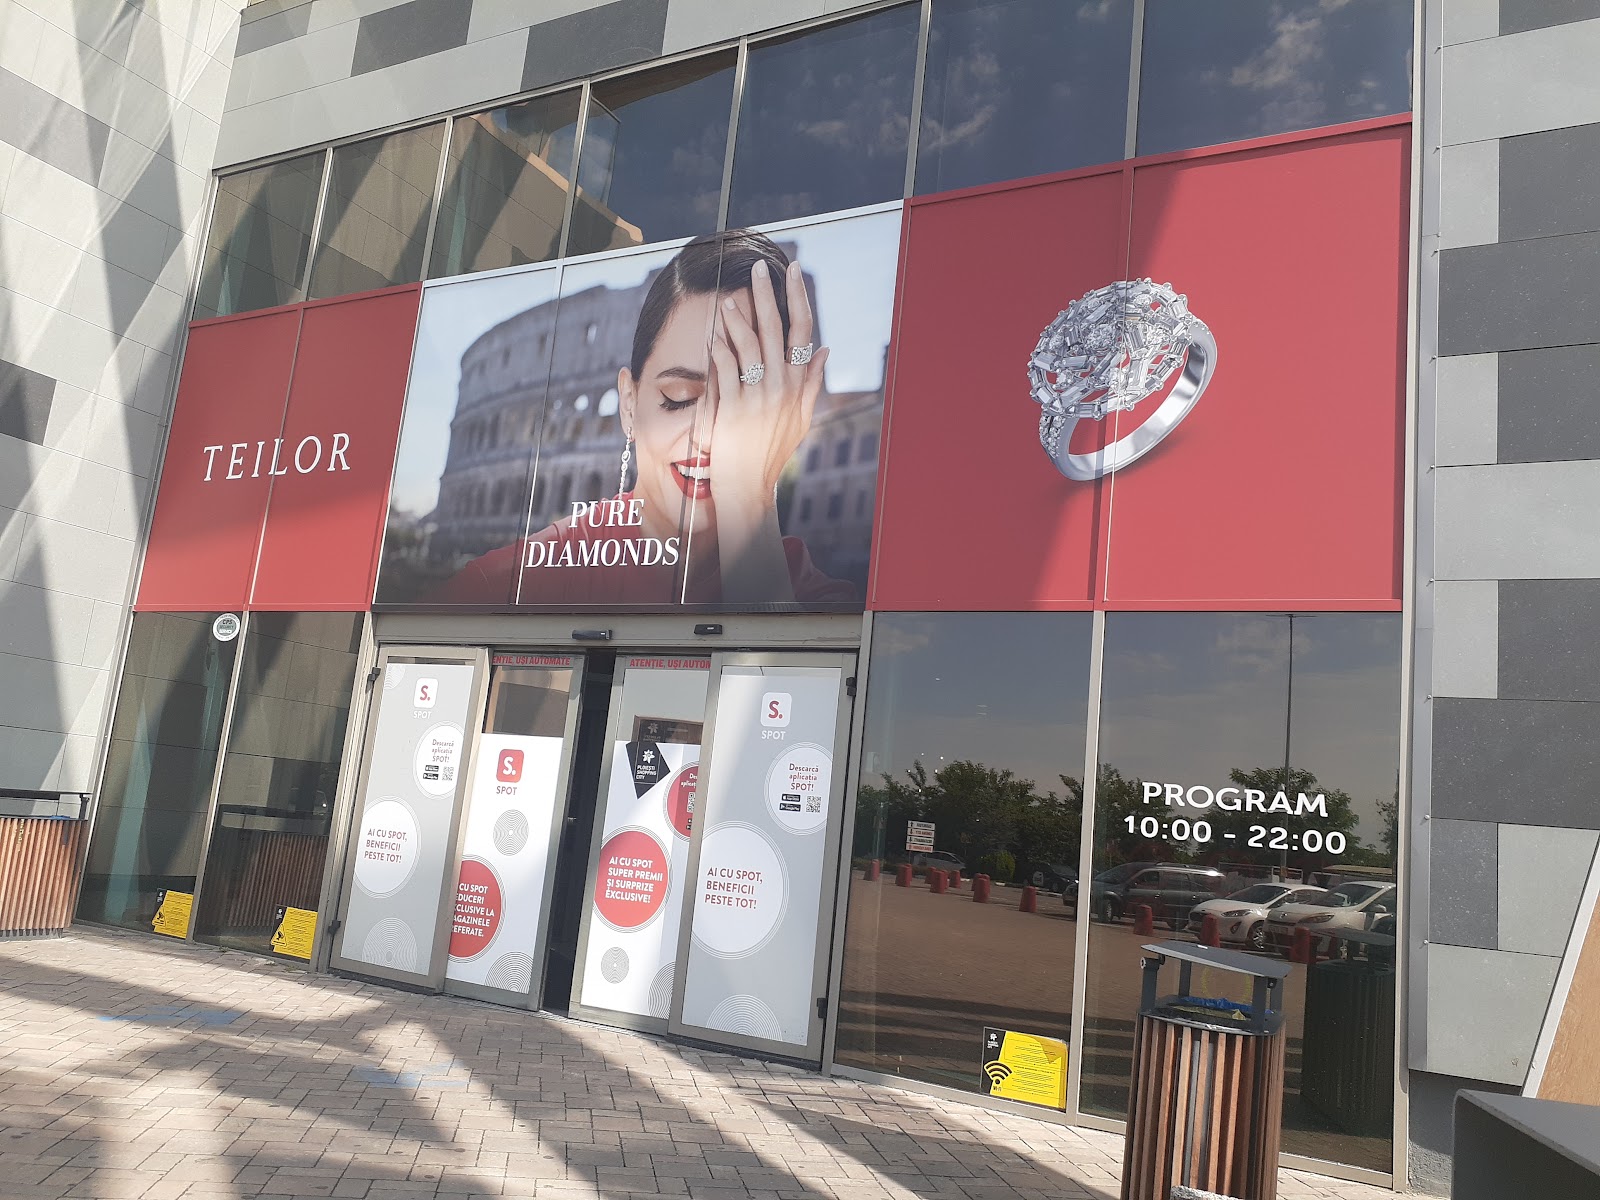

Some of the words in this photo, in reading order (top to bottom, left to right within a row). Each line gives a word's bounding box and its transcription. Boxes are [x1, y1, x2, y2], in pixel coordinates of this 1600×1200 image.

[203, 433, 351, 481] TEILOR
[569, 499, 644, 528] PURE
[525, 536, 680, 568] DIAMONDS
[529, 656, 571, 666] AUTOMATE
[413, 710, 432, 719] SPOT
[761, 730, 786, 741] SPOT
[496, 785, 517, 796] SPOT
[791, 783, 814, 792] SPOT!
[1142, 782, 1329, 818] PROGRAM
[367, 828, 376, 837] AI
[376, 829, 387, 838] CU
[387, 830, 408, 842] SPOT,
[1124, 815, 1212, 843] 10:00
[1247, 825, 1347, 855] 22:00
[366, 839, 401, 852] BENEFICII
[364, 850, 385, 862] PESTE
[385, 852, 402, 864] TOT!
[609, 856, 618, 865] AI
[619, 857, 631, 866] CU
[632, 858, 653, 869] SPOT
[608, 867, 634, 878] SUPER
[635, 870, 663, 882] PREMII
[707, 867, 718, 877] AI
[719, 868, 734, 879] CU
[735, 869, 763, 884] SPOT,
[459, 883, 470, 892] CU
[470, 884, 488, 894] SPOT
[615, 879, 654, 892] SURPRIZE
[706, 881, 754, 895] BENEFICII
[605, 889, 651, 904] EXCLUSIVE!
[704, 893, 733, 907] PESTE
[735, 897, 757, 910] TOT!
[454, 904, 485, 916] CLUSIVE
[485, 908, 495, 917] LA
[452, 925, 484, 937] EFERATE.
